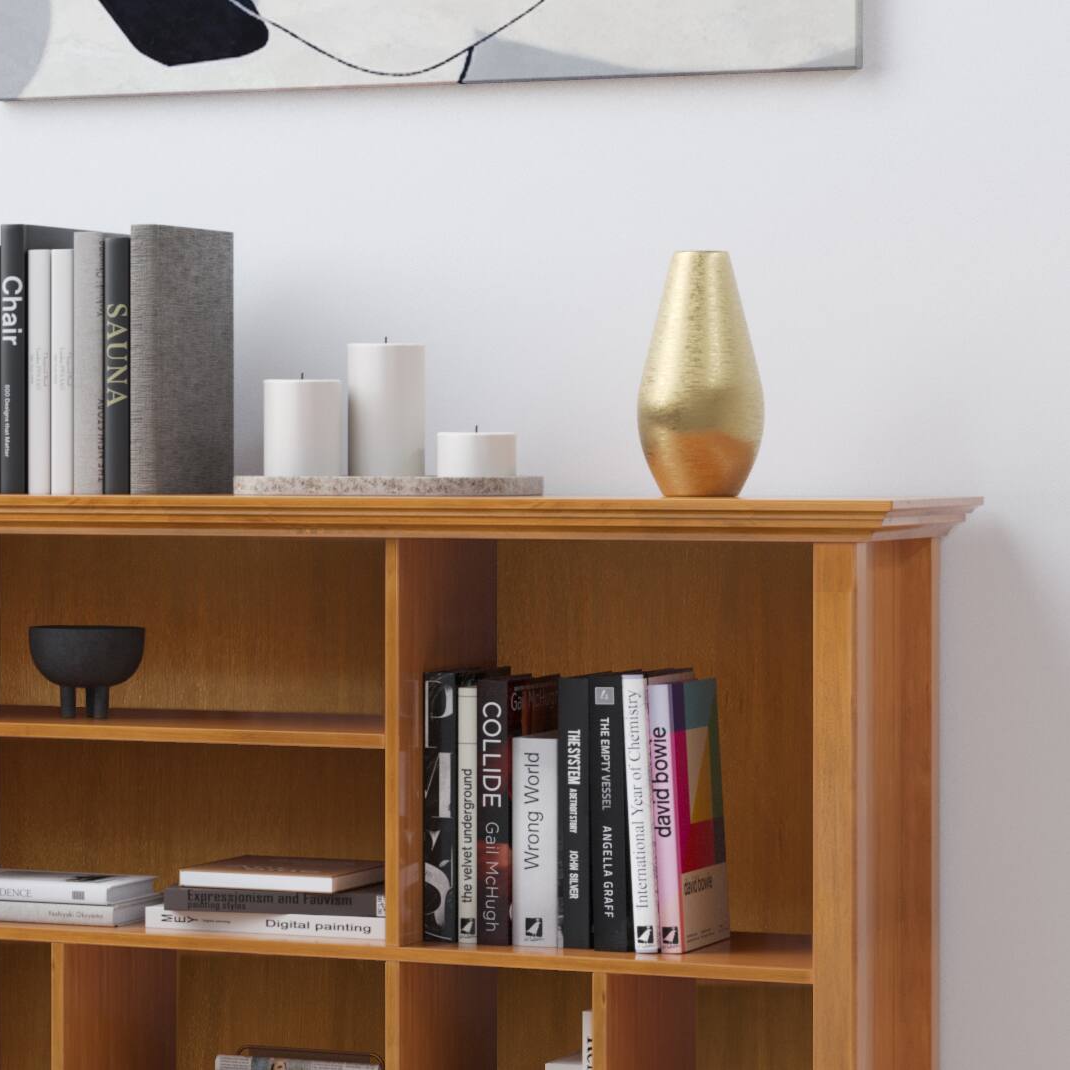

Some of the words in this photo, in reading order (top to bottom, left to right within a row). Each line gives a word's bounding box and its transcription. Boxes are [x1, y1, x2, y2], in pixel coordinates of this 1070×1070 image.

[2, 275, 24, 346] Chair
[106, 303, 128, 407] SAUNA
[2, 398, 10, 422] Designs
[600, 716, 610, 737] THE
[628, 690, 642, 762] Chemistry
[482, 701, 502, 808] COLLIDE
[600, 739, 611, 772] EMPTY
[651, 726, 669, 784] bowie
[524, 752, 540, 805] World
[601, 774, 612, 811] VESSEL
[630, 767, 642, 781] of
[461, 768, 475, 844] underground
[632, 784, 643, 816] Year
[652, 788, 672, 838] david
[485, 822, 500, 854] Gail
[524, 811, 544, 870] Wrong
[602, 825, 614, 877] ANGELLA
[461, 847, 473, 884] velvet
[569, 850, 579, 870] JOHN
[632, 821, 649, 908] International
[187, 889, 274, 906] Expressionism
[277, 891, 299, 905] and
[303, 892, 353, 906] Fauvism
[461, 884, 473, 903] the
[482, 862, 500, 932] McHugh
[569, 872, 579, 899] SILVER
[603, 881, 614, 918] GRAFF
[265, 918, 310, 931] Digital
[315, 922, 372, 934] painting
